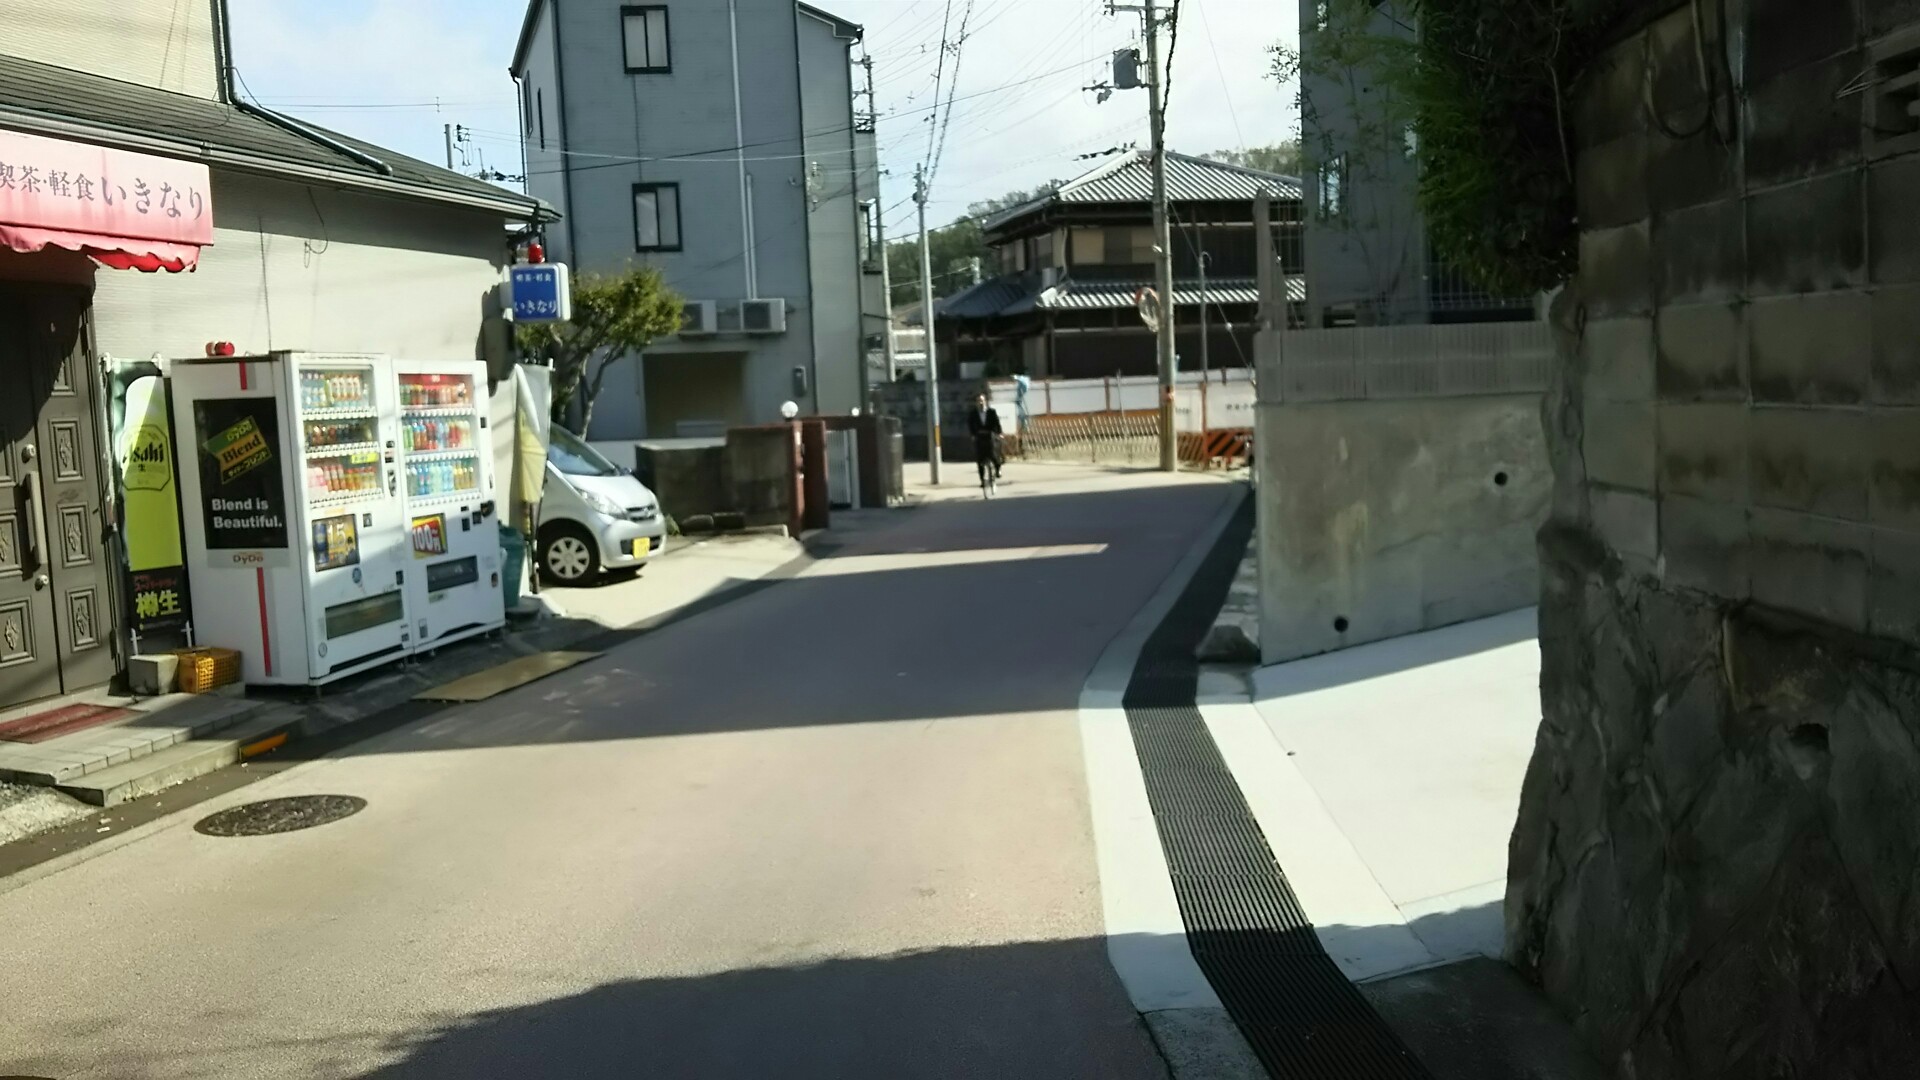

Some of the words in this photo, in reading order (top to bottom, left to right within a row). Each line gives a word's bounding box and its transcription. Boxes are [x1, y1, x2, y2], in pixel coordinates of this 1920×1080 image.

[101, 176, 203, 220] いきなり
[514, 300, 557, 315] いきなり
[222, 434, 262, 463] Blend
[211, 498, 253, 511] Blend
[256, 497, 269, 510] is
[213, 515, 283, 529] Beautiful.
[232, 554, 264, 565] DyDo
